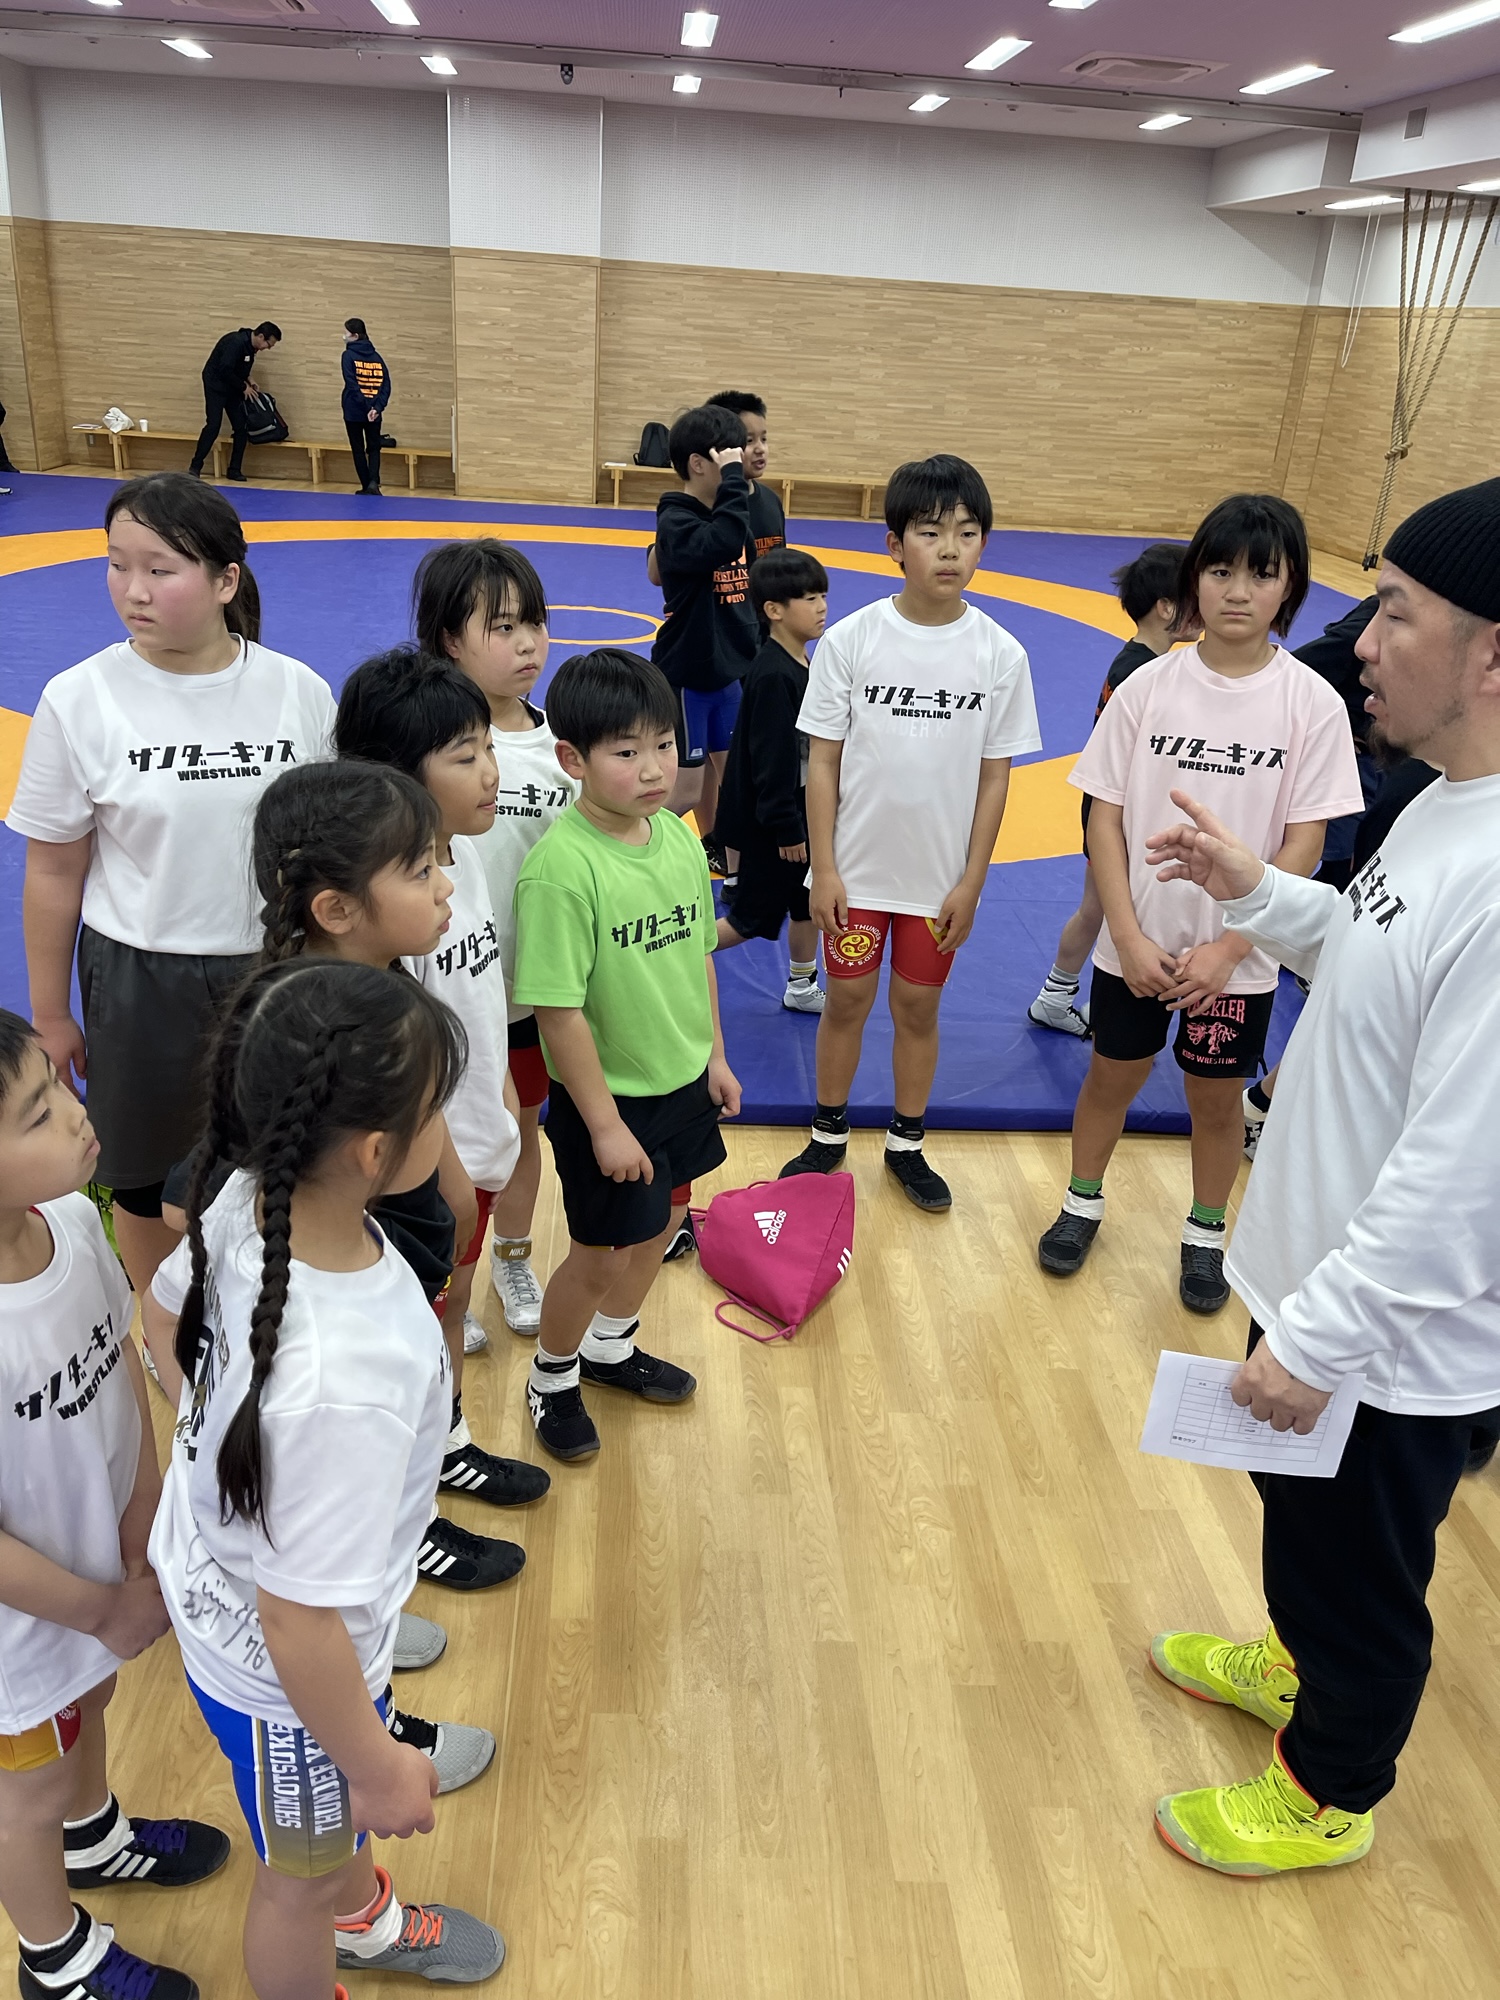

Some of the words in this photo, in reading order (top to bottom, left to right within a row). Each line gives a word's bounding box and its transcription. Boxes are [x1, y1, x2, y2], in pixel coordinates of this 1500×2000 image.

[863, 685, 986, 711] サンダーキッズ
[892, 707, 951, 719] WRESTLING
[128, 739, 296, 772] サンダーキッズ
[1150, 735, 1287, 770] サンダーキッズ
[1177, 759, 1246, 776] WRESTLING
[177, 766, 261, 781] WRESTLING
[496, 783, 570, 807] ーキッズ
[495, 805, 542, 818] ESTLING
[1359, 851, 1407, 934] ダーキッズ
[611, 896, 702, 949] サンダーキッ
[436, 912, 498, 976] サンダーキ
[644, 927, 692, 954] WRESTLING
[828, 934, 844, 965] WRESTLI
[469, 946, 500, 978] WRESTLIN
[1182, 1049, 1195, 1061] KIDS
[1196, 1055, 1237, 1065] WRESTLING
[766, 1209, 787, 1245] adidas
[508, 1247, 526, 1257] NIKE
[14, 1312, 113, 1422] サンダーキッ
[57, 1343, 120, 1421] WRESTLING
[308, 1763, 343, 1836] THUNDER
